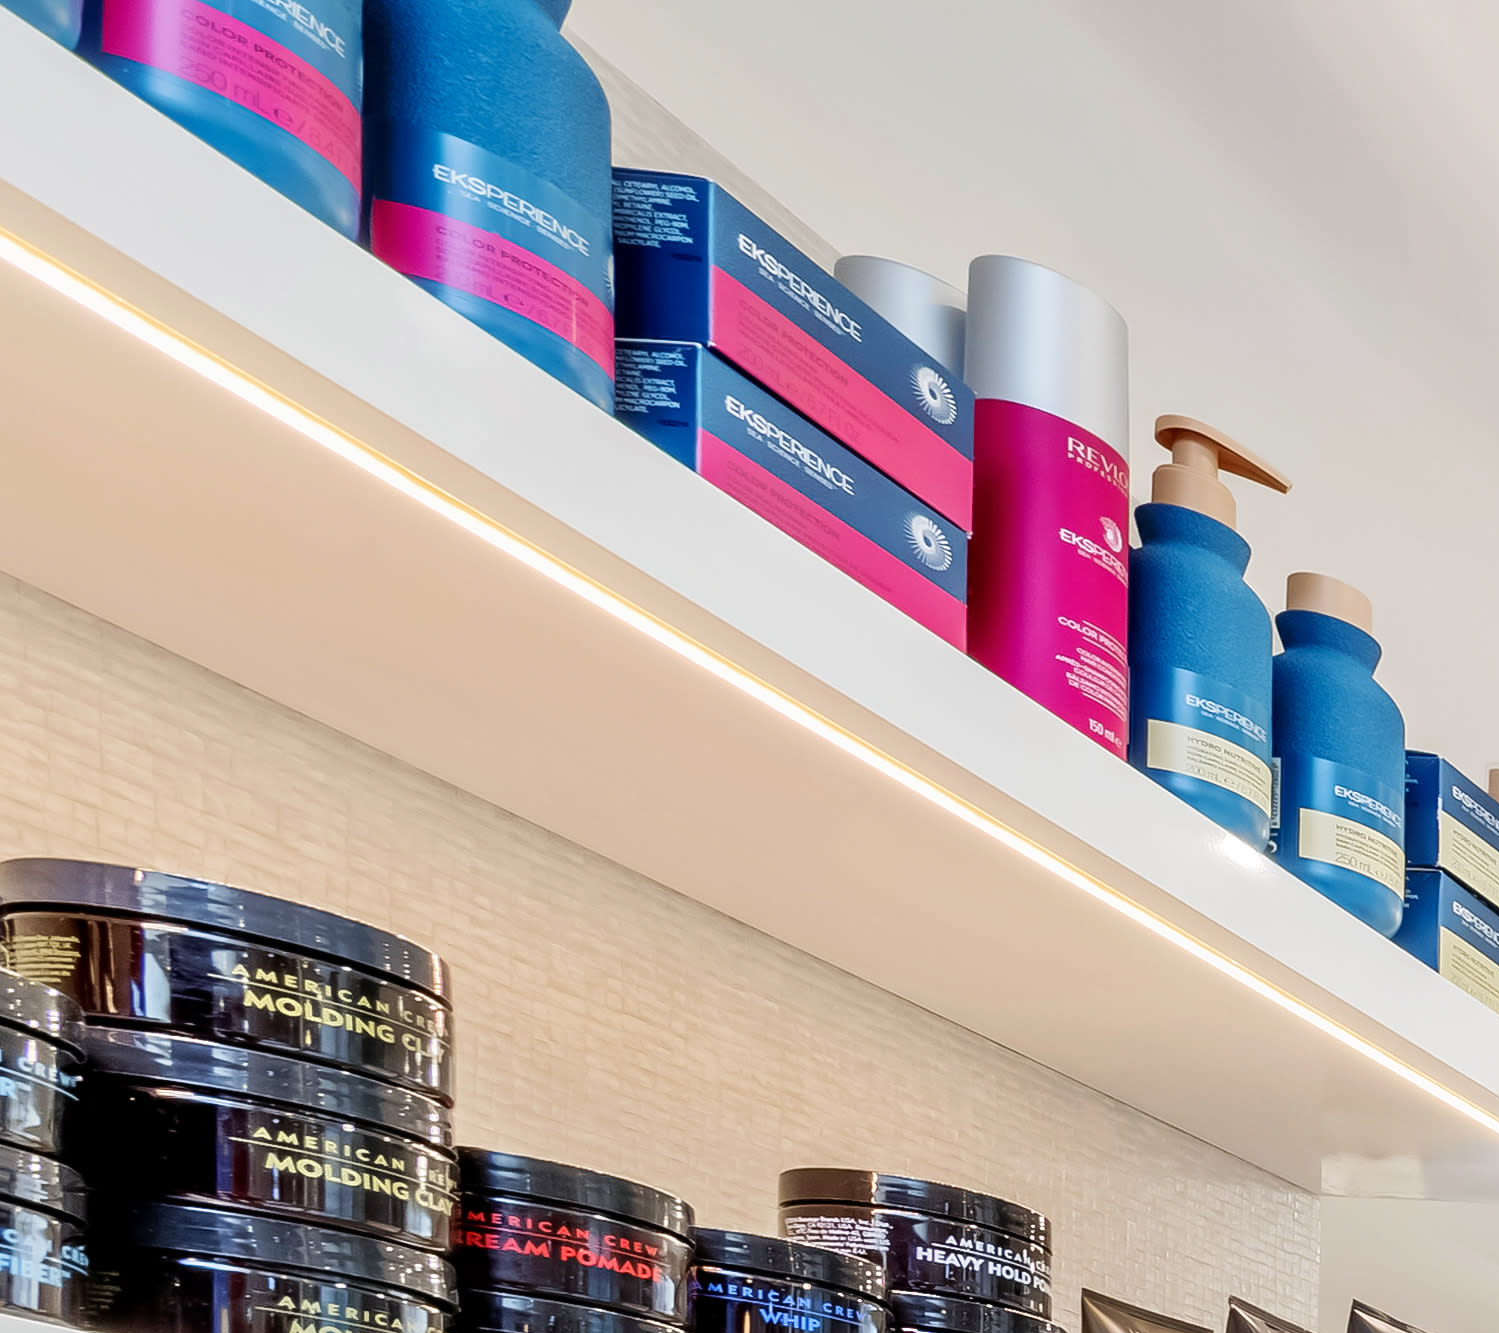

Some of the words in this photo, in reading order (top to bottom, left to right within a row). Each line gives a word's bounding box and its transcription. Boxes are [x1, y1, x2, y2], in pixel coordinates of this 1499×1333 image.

[432, 163, 590, 257] EKSPERIENCE
[737, 233, 863, 343] EKSPERIENCE
[725, 395, 856, 496] EKSPERIENCE
[231, 963, 390, 1015] AMERICAN
[241, 988, 394, 1045] MOLDING
[252, 1126, 405, 1171] AMERICAN
[264, 1150, 410, 1201] MOLDING
[464, 1206, 589, 1240] MERICAN
[604, 1235, 660, 1256] CREW
[561, 1246, 663, 1283] POMADE
[916, 1246, 984, 1272] HEAVY
[988, 1262, 1028, 1285] HOLD
[759, 1309, 821, 1332] WHIP
